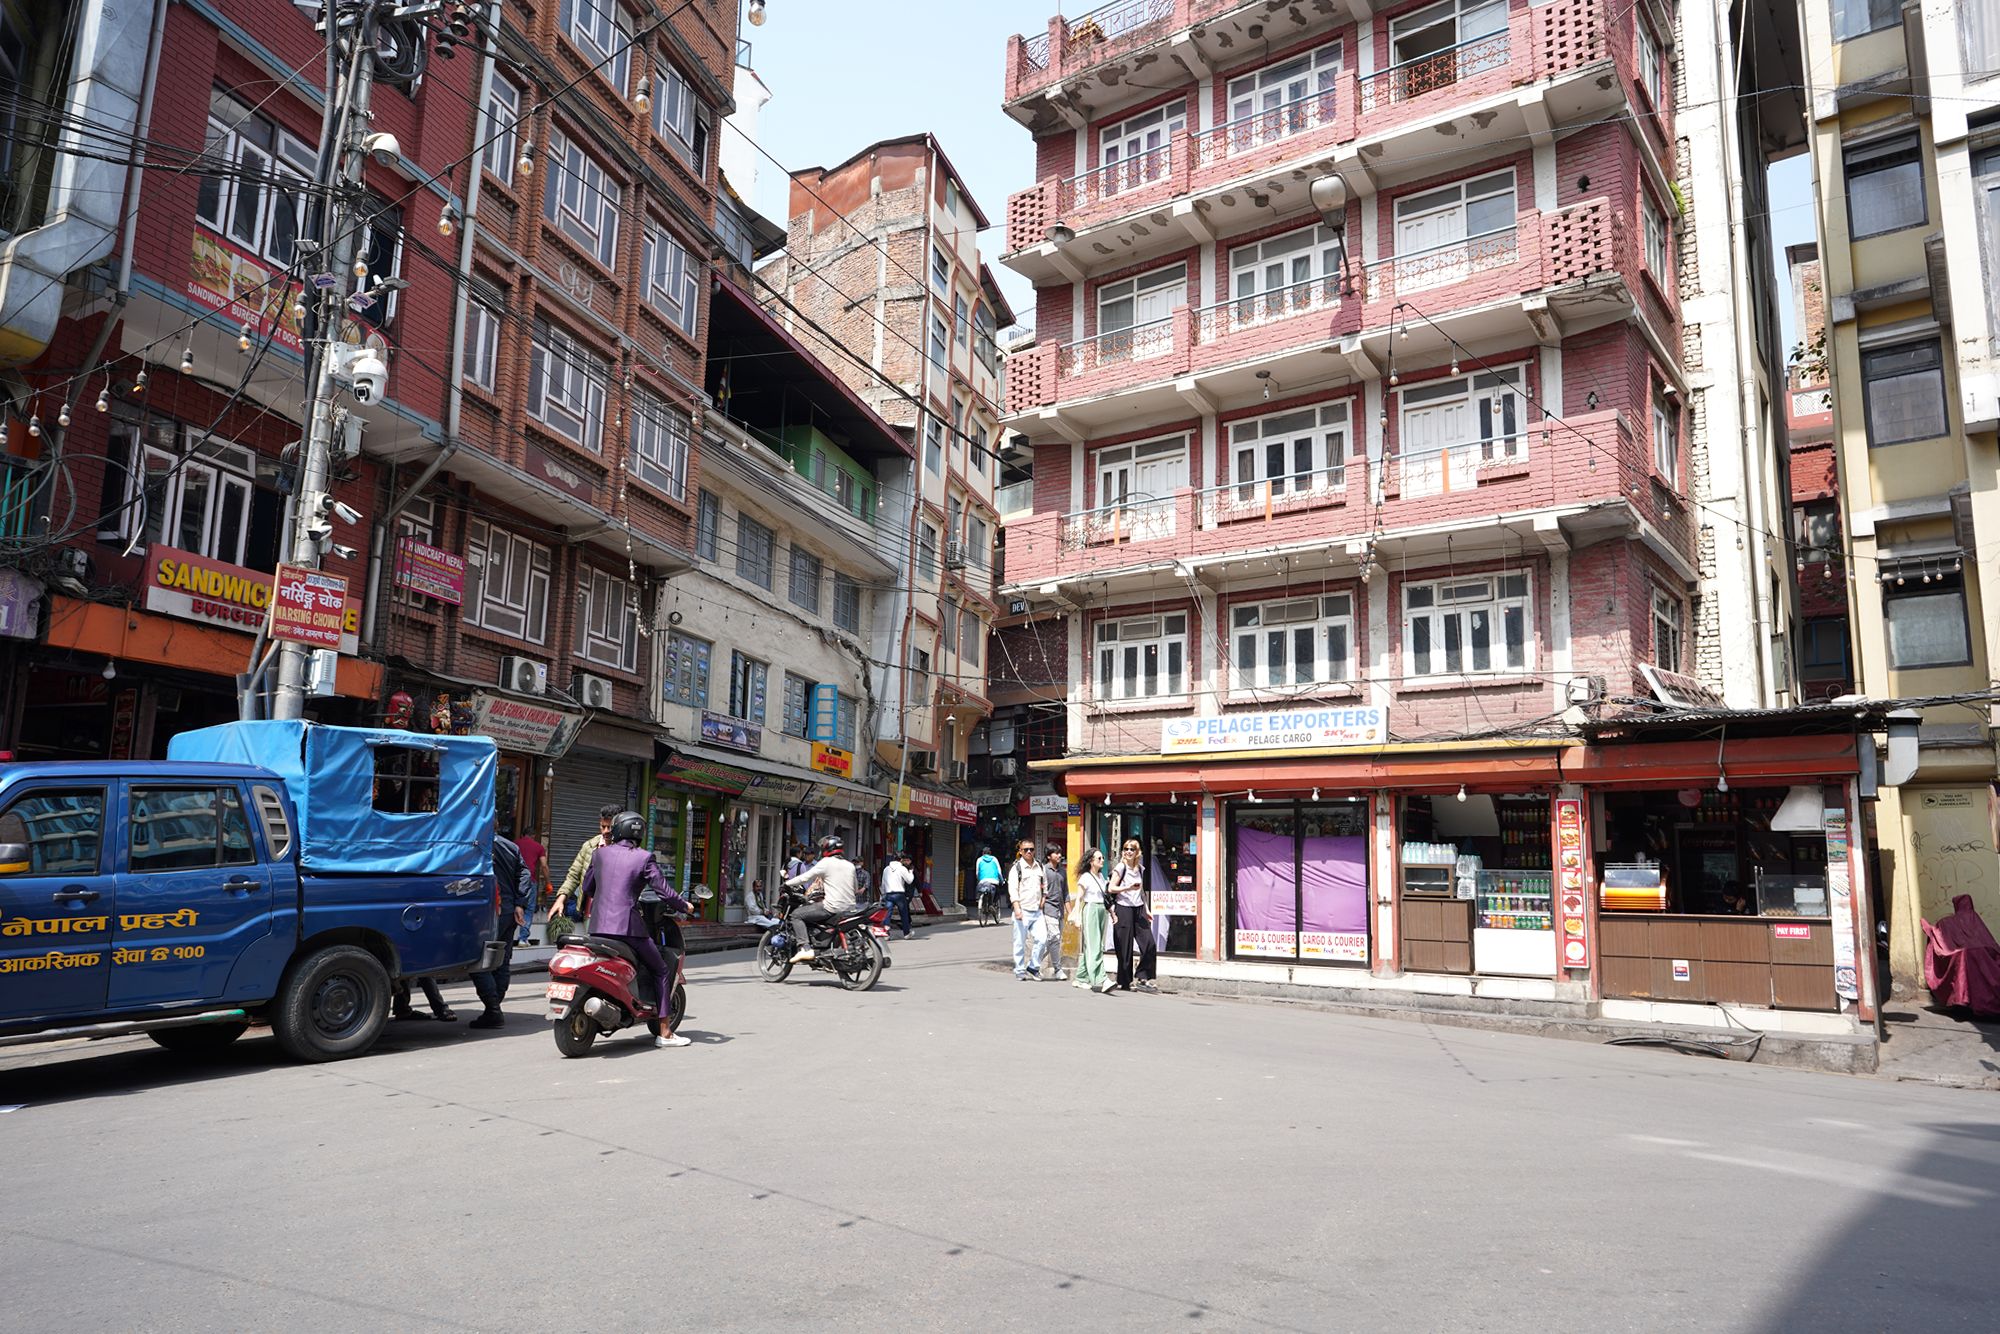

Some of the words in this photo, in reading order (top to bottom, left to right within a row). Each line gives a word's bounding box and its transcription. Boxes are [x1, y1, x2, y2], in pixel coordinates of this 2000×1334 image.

[187, 281, 227, 311] SANDWICH
[231, 305, 260, 327] BURGER
[282, 330, 297, 346] DOG
[446, 554, 464, 570] NEPAL
[318, 588, 343, 609] चोक
[275, 605, 311, 625] NARSING
[312, 612, 341, 629] CHOWK
[1197, 717, 1263, 735] PELAGE
[1269, 709, 1380, 731] EXPORTERS
[1208, 735, 1238, 745] FedEx
[1248, 734, 1281, 745] PELAGE
[1283, 732, 1313, 744] CARGO
[1323, 729, 1347, 737] SKY
[669, 754, 705, 771] Student
[1, 916, 110, 937] नेपाल
[118, 908, 201, 932] प्रहरी
[1237, 932, 1259, 943] CARGO
[1261, 933, 1266, 943] &
[1267, 933, 1296, 945] COURIER
[1777, 927, 1789, 936] PAY
[1790, 927, 1808, 936] FIRST
[1302, 934, 1325, 945] CARGO
[1327, 935, 1333, 946] &
[1334, 936, 1365, 947] COURIER
[0, 951, 102, 974] आकस्मिक
[112, 947, 147, 966] सेवा
[173, 945, 205, 960] १००
